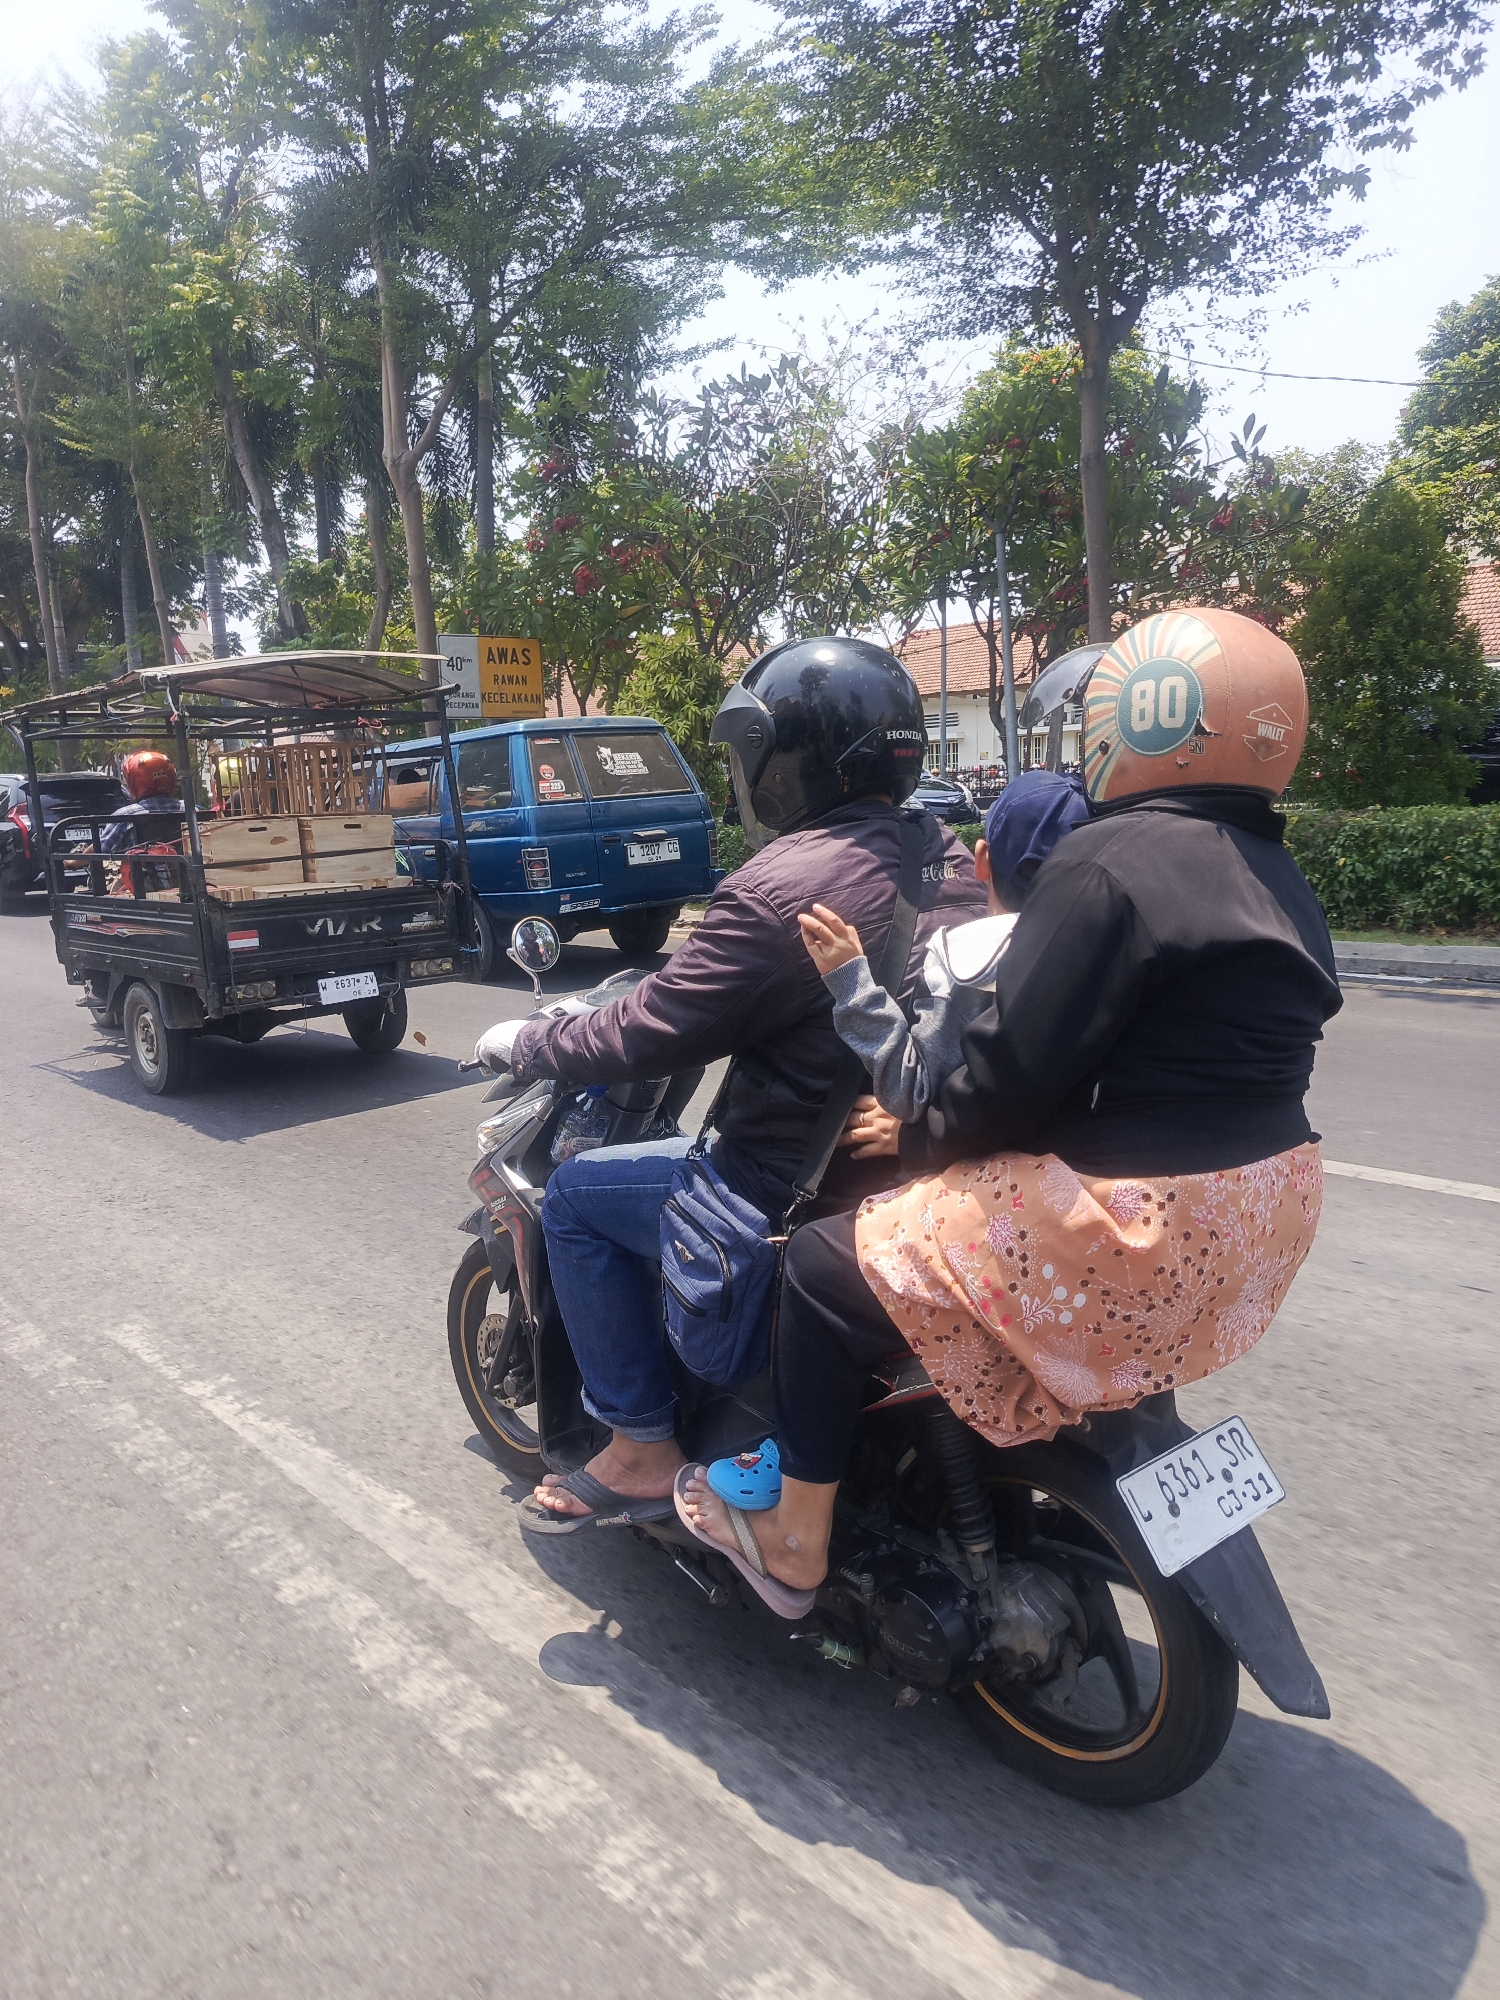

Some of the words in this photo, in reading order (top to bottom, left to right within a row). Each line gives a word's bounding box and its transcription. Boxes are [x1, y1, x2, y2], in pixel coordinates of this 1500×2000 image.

[486, 647, 532, 666] AWAS
[493, 674, 527, 686] RAWAN
[481, 692, 542, 704] KECELAKAAN
[1131, 675, 1188, 733] 80
[886, 730, 923, 742] HONDA
[1257, 722, 1286, 742] WALET
[1188, 739, 1205, 755] SNI
[629, 847, 635, 857] L
[640, 843, 660, 857] 1207
[667, 841, 679, 853] CG
[320, 981, 327, 992] W
[335, 977, 356, 990] 2637
[364, 974, 374, 985] ZV
[1128, 1488, 1153, 1522] L
[1155, 1449, 1215, 1504] 6361
[1215, 1427, 1254, 1467] SR
